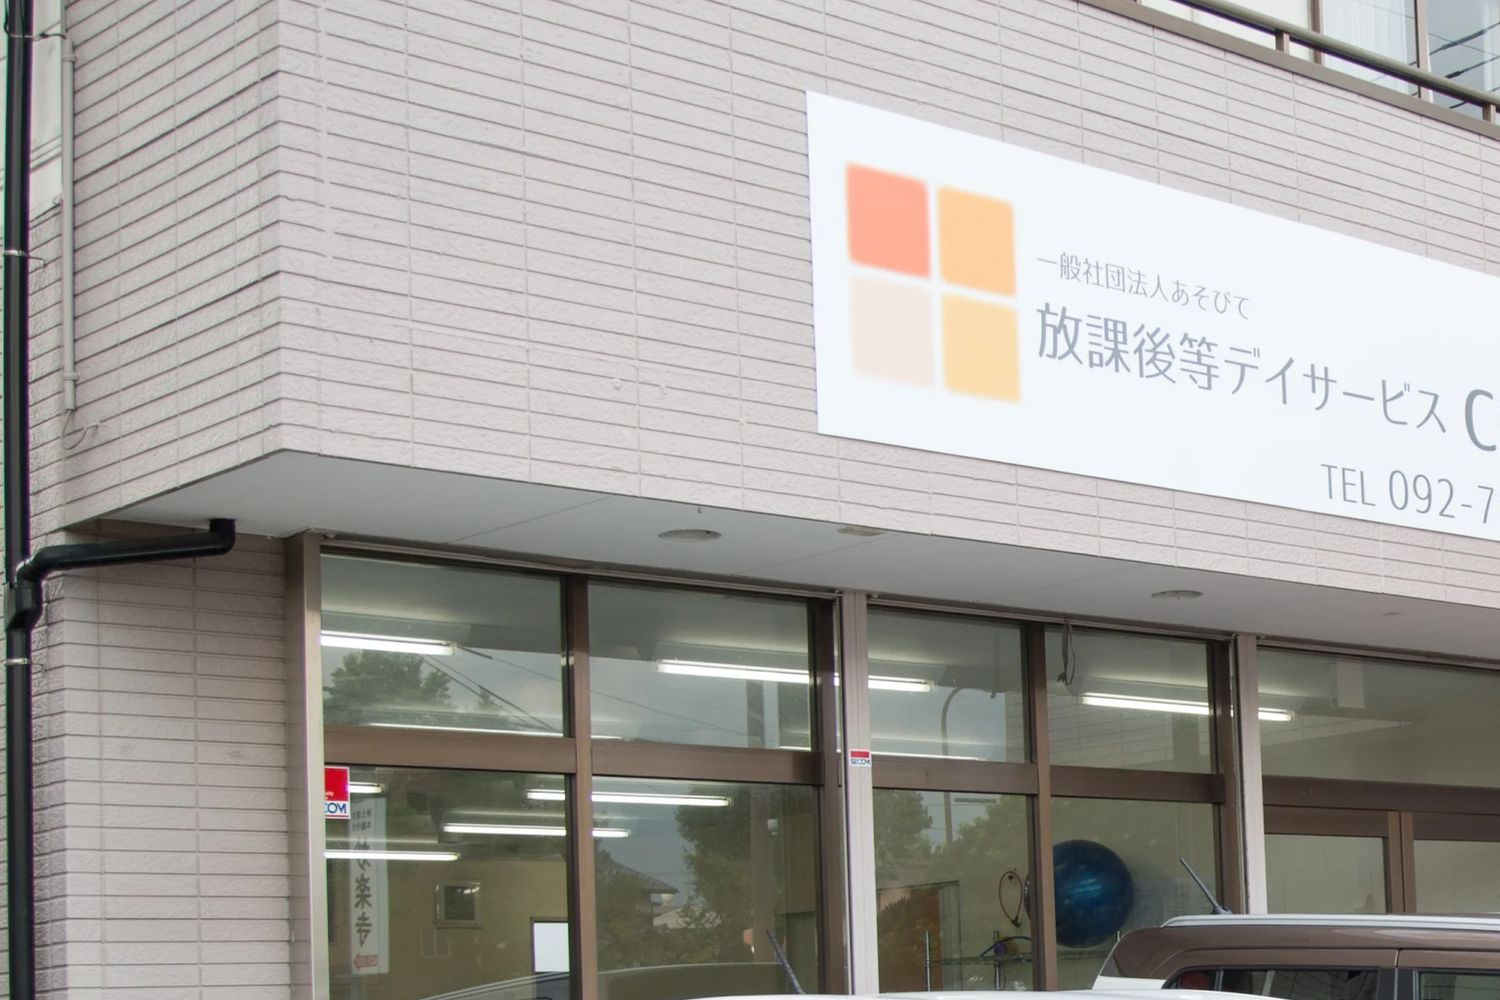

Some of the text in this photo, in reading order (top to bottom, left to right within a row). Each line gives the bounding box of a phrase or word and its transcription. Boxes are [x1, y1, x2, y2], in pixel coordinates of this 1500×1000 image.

[1037, 251, 1250, 320] 一般社団法人あそびて
[1036, 302, 1447, 433] 放課後等デイサービス
[1321, 463, 1376, 506] TEL
